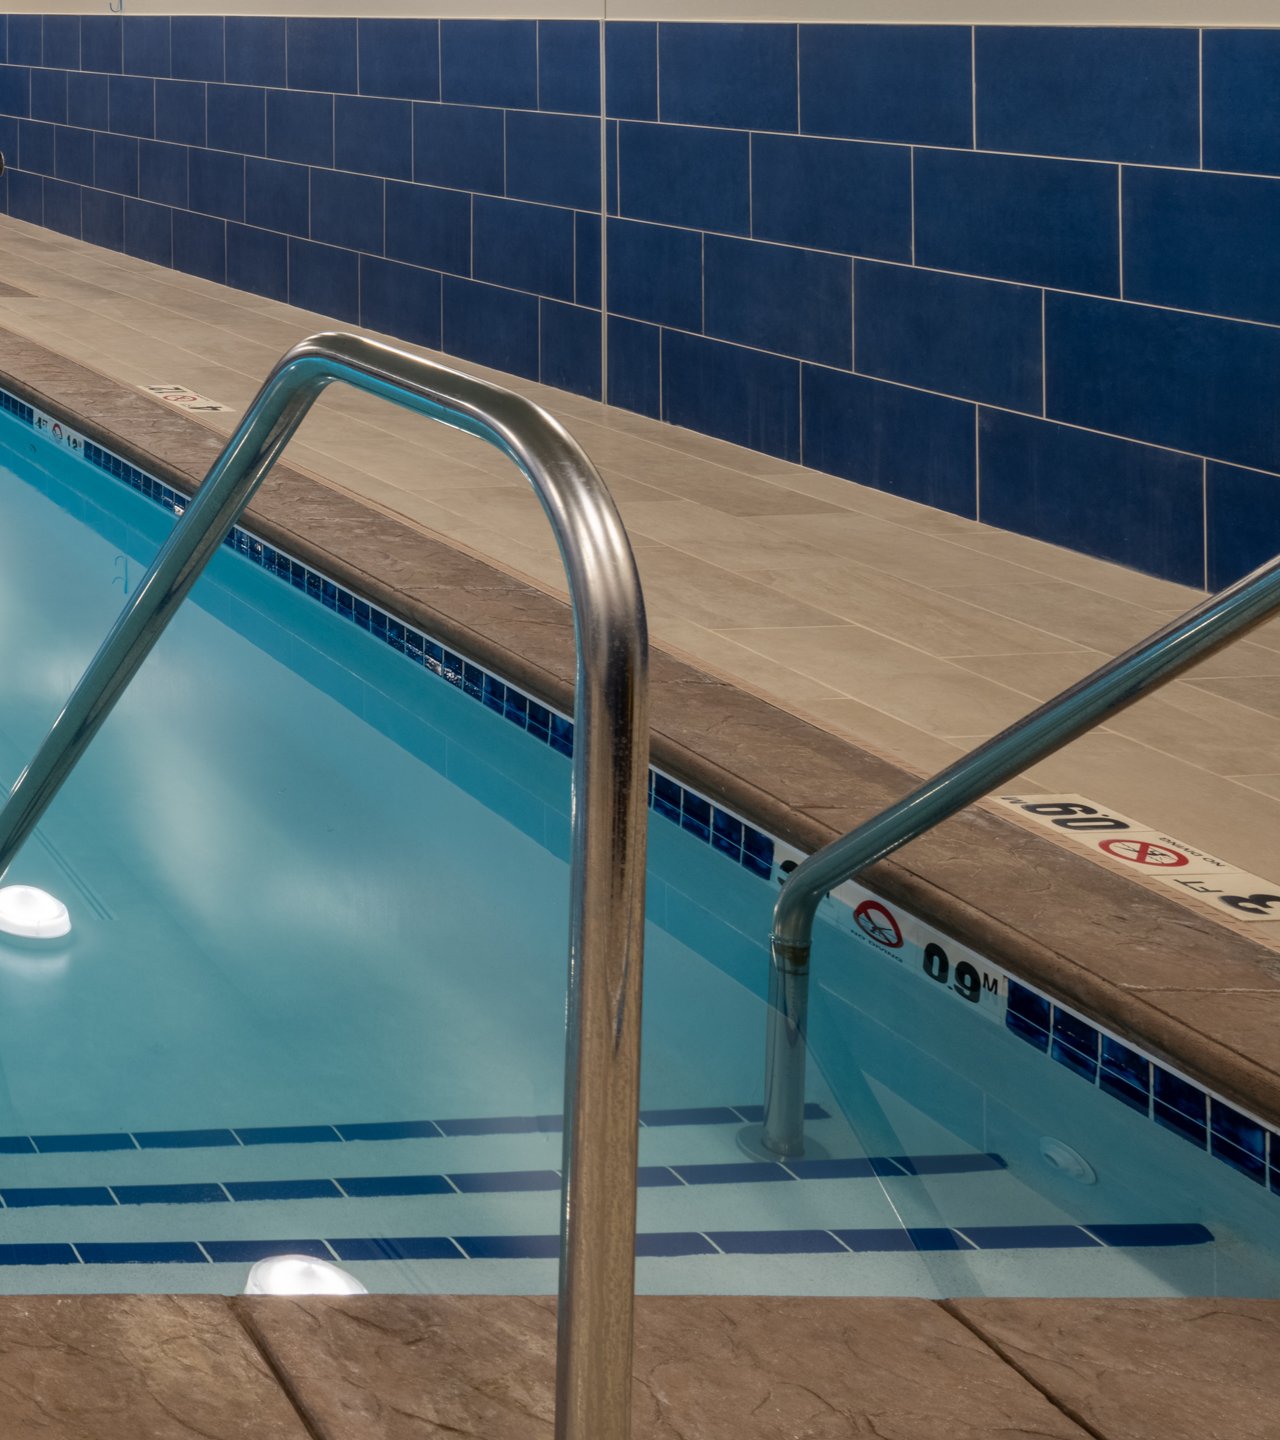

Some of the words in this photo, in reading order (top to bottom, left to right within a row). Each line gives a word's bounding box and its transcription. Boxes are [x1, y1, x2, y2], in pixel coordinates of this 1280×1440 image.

[1158, 837, 1203, 856] DIVING
[1203, 857, 1225, 867] NO
[1173, 879, 1224, 893] FT
